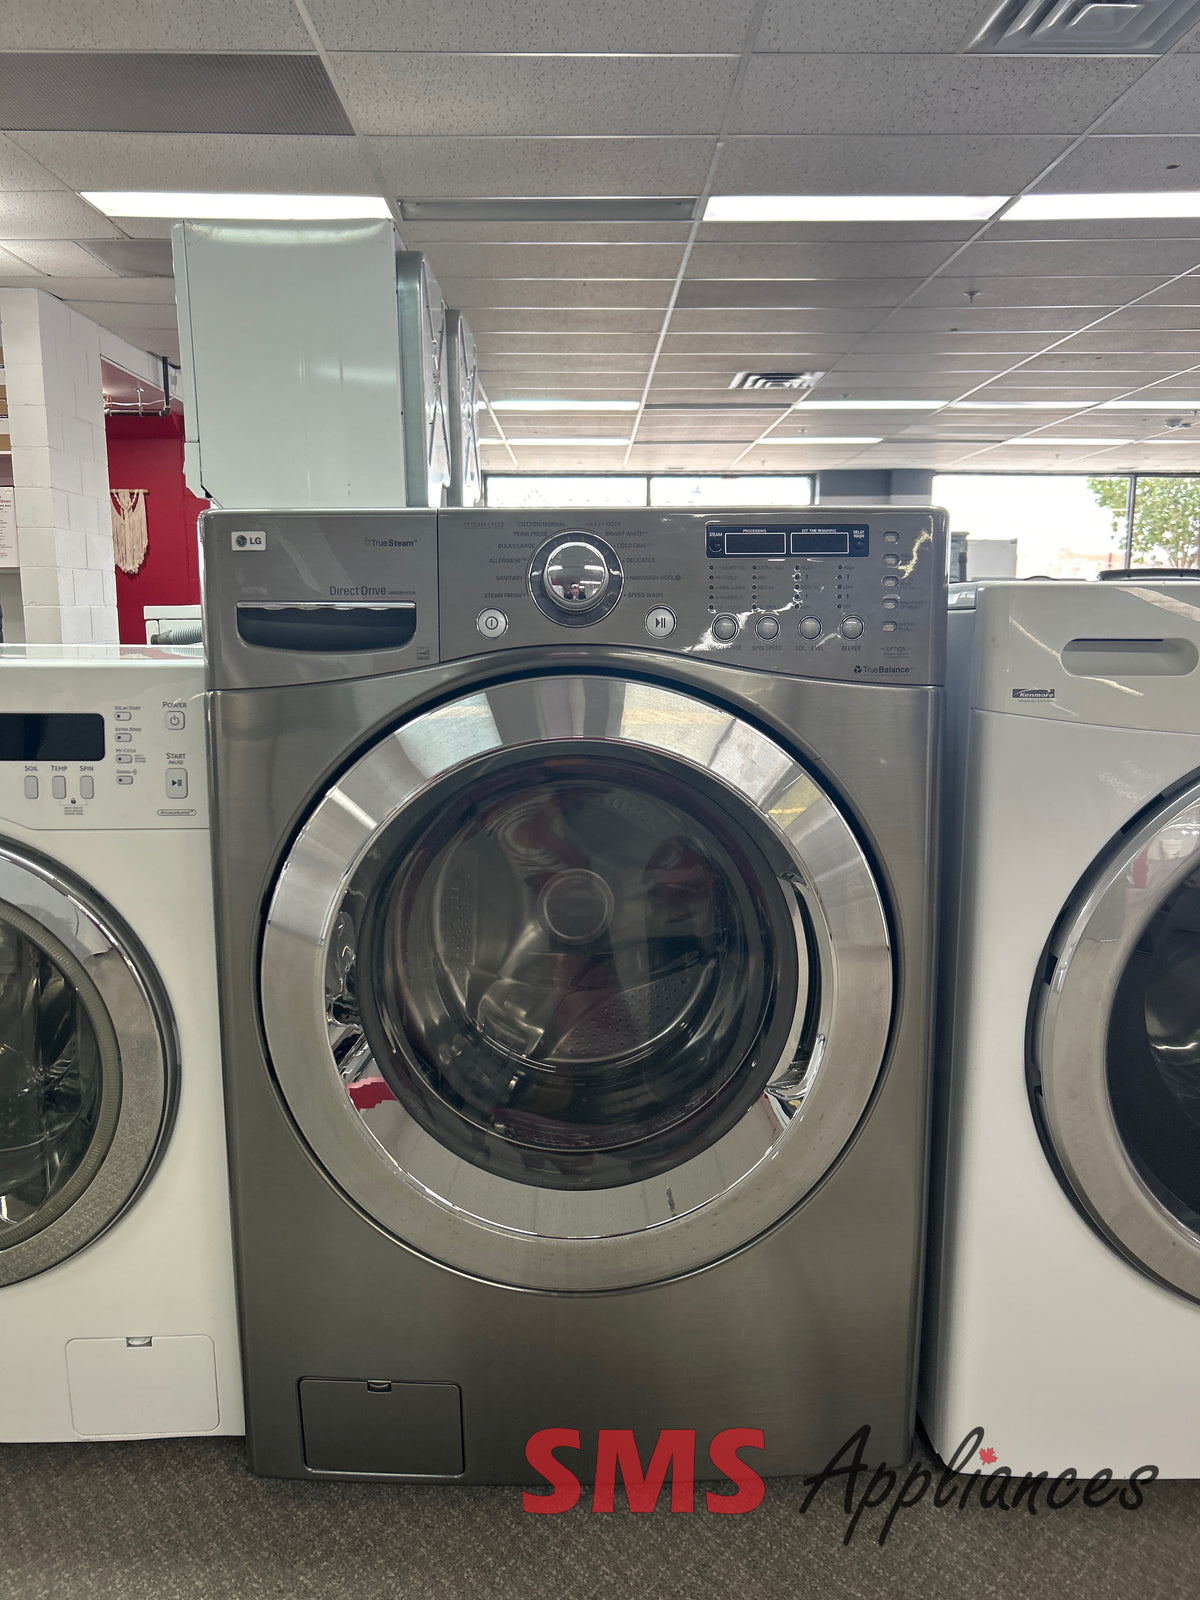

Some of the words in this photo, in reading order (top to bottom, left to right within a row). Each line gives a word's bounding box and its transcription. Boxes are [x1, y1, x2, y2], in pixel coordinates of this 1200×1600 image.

[249, 537, 262, 545] LG
[329, 585, 359, 596] Direct
[360, 585, 387, 596] Drive
[162, 702, 187, 710] POWER
[166, 752, 186, 760] START
